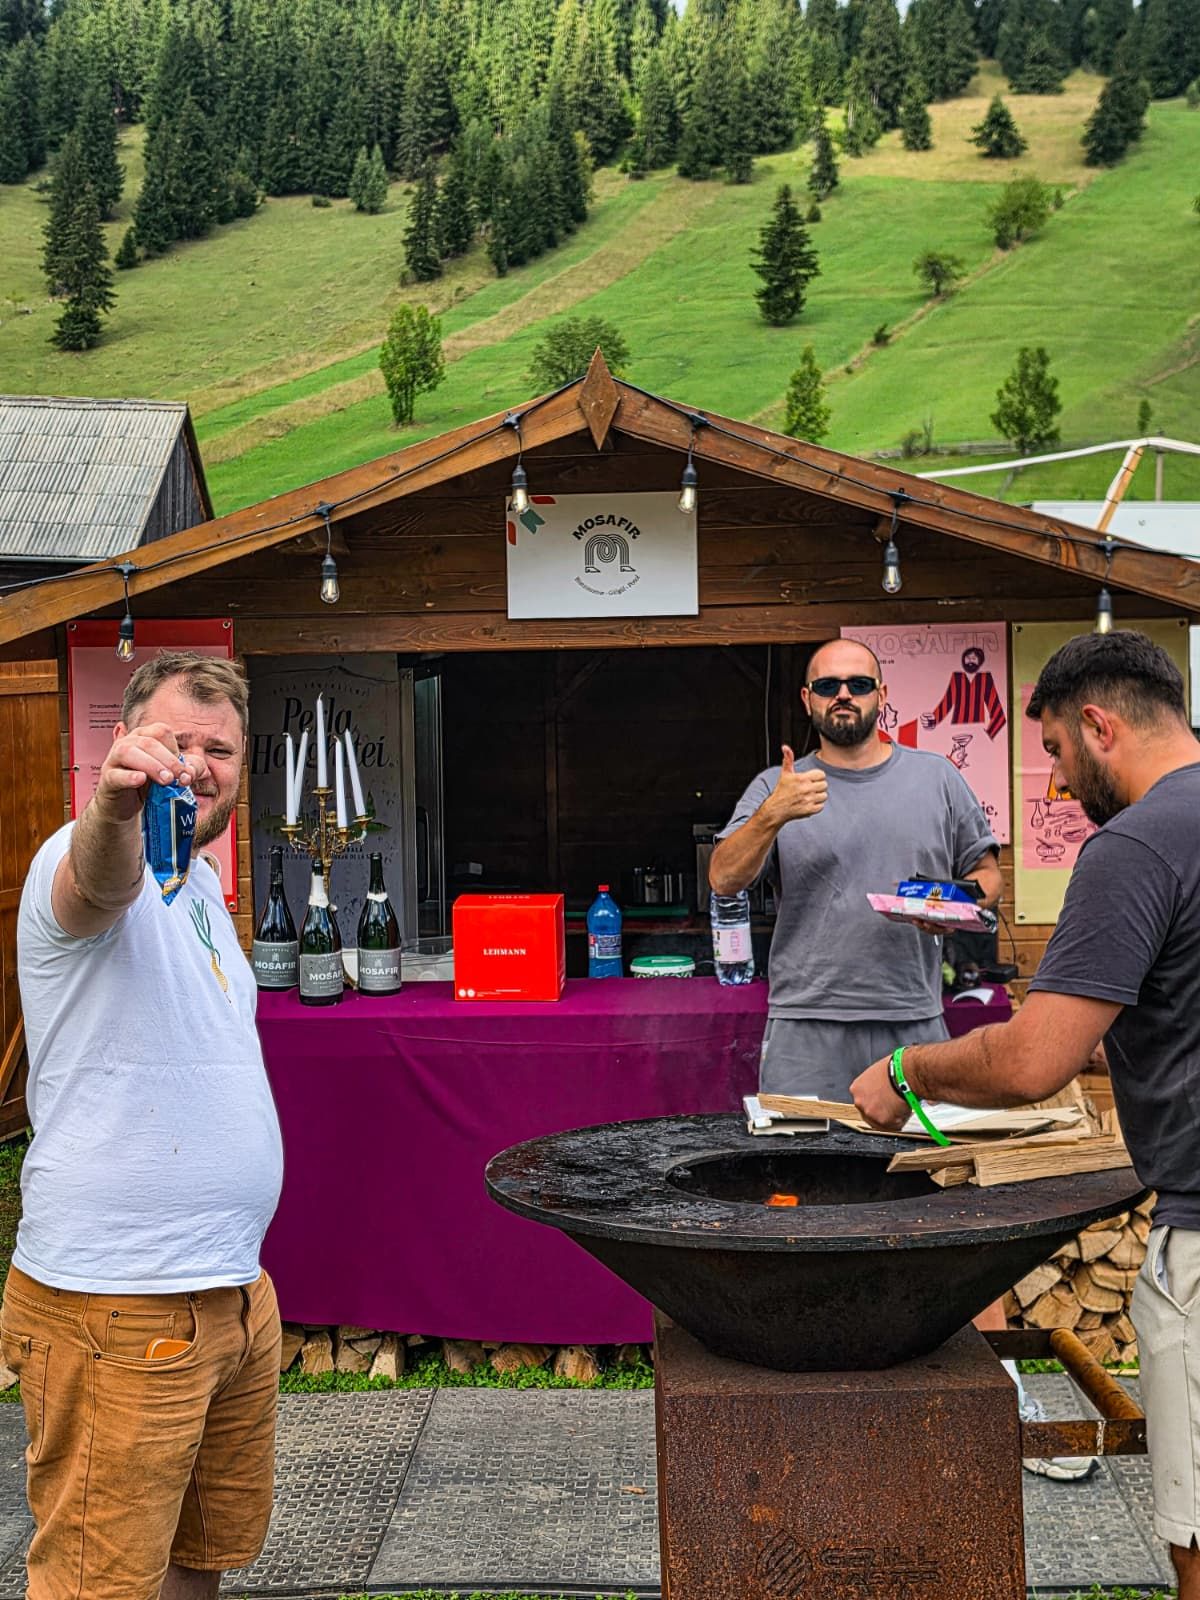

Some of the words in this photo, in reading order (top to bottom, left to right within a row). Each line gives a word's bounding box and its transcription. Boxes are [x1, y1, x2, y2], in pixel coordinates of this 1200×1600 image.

[572, 514, 641, 540] MOSAFIR
[281, 697, 358, 735] Pela
[255, 961, 296, 970] MOSAFIR
